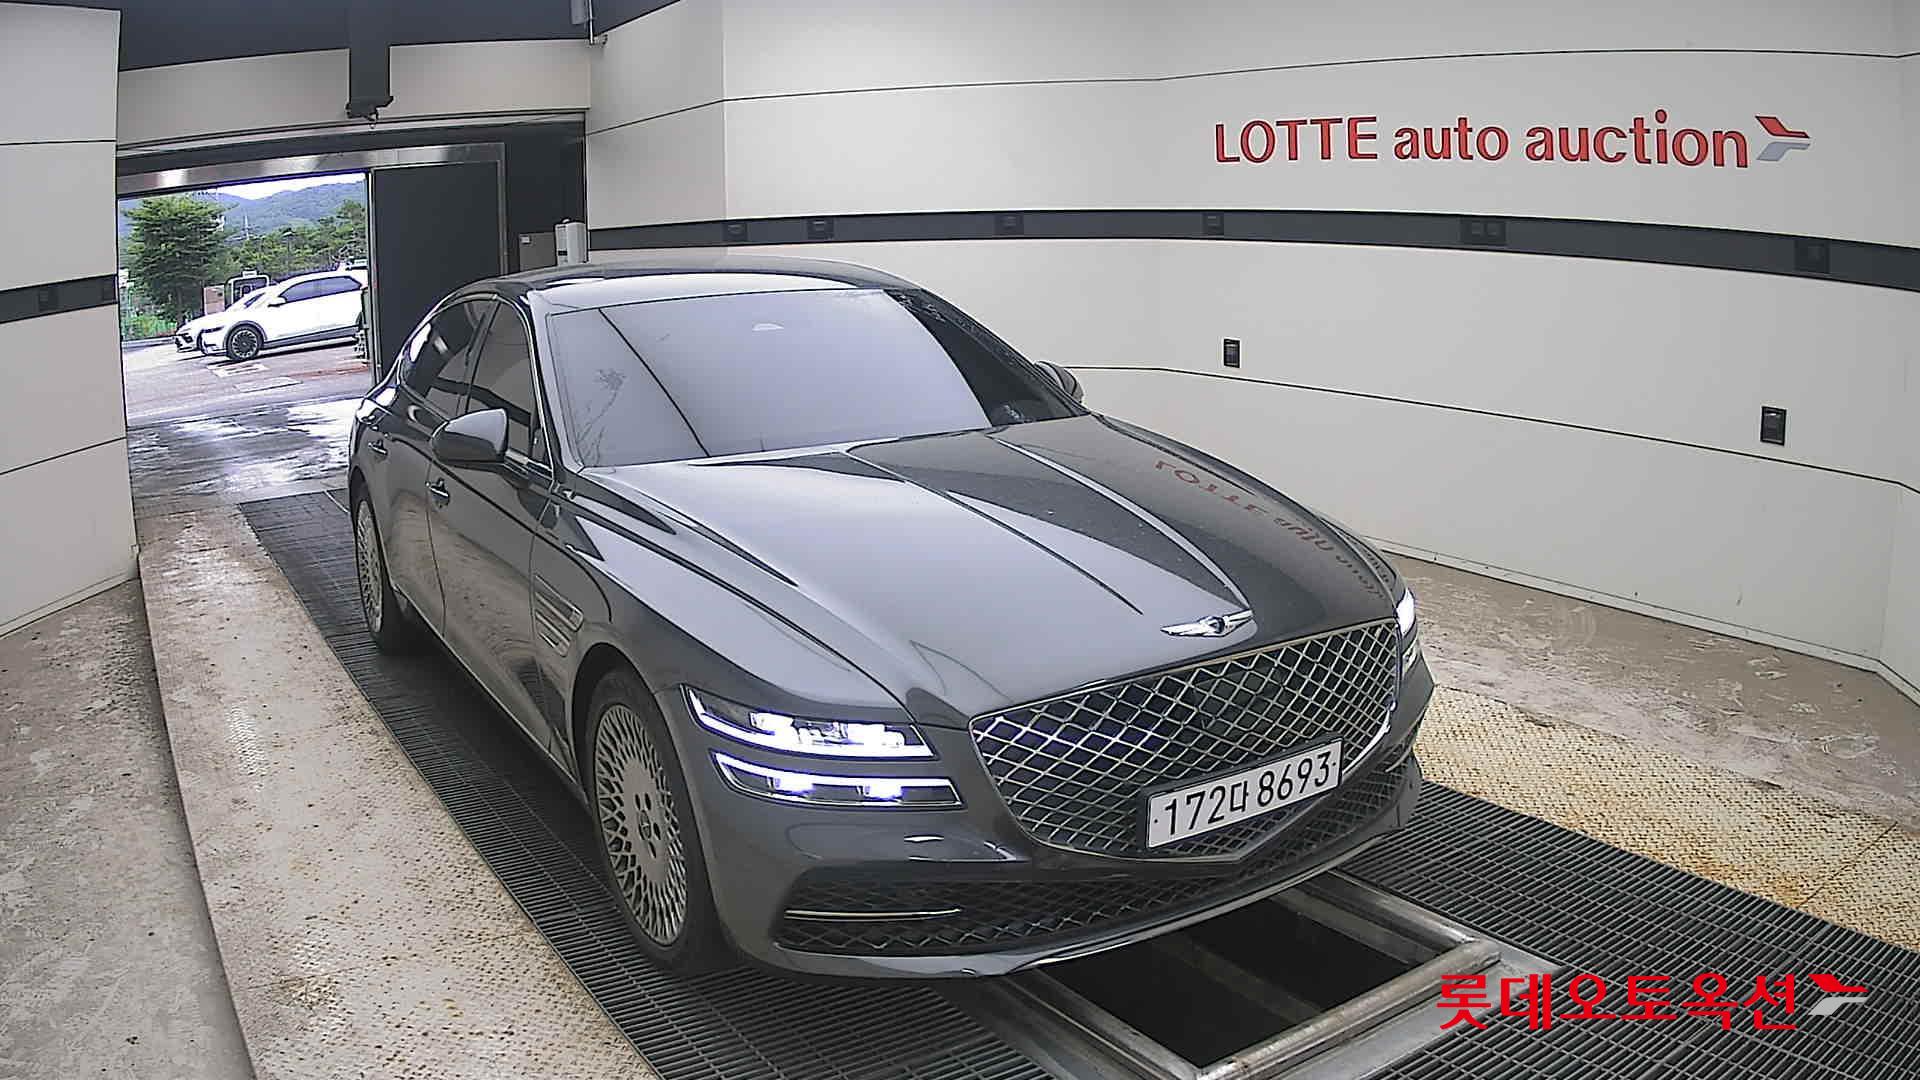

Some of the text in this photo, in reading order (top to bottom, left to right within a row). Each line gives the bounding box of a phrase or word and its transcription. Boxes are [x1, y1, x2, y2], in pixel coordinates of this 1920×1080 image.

[1215, 109, 1749, 168] LOTTE auto auction
[1164, 751, 1331, 836] 172다 8693
